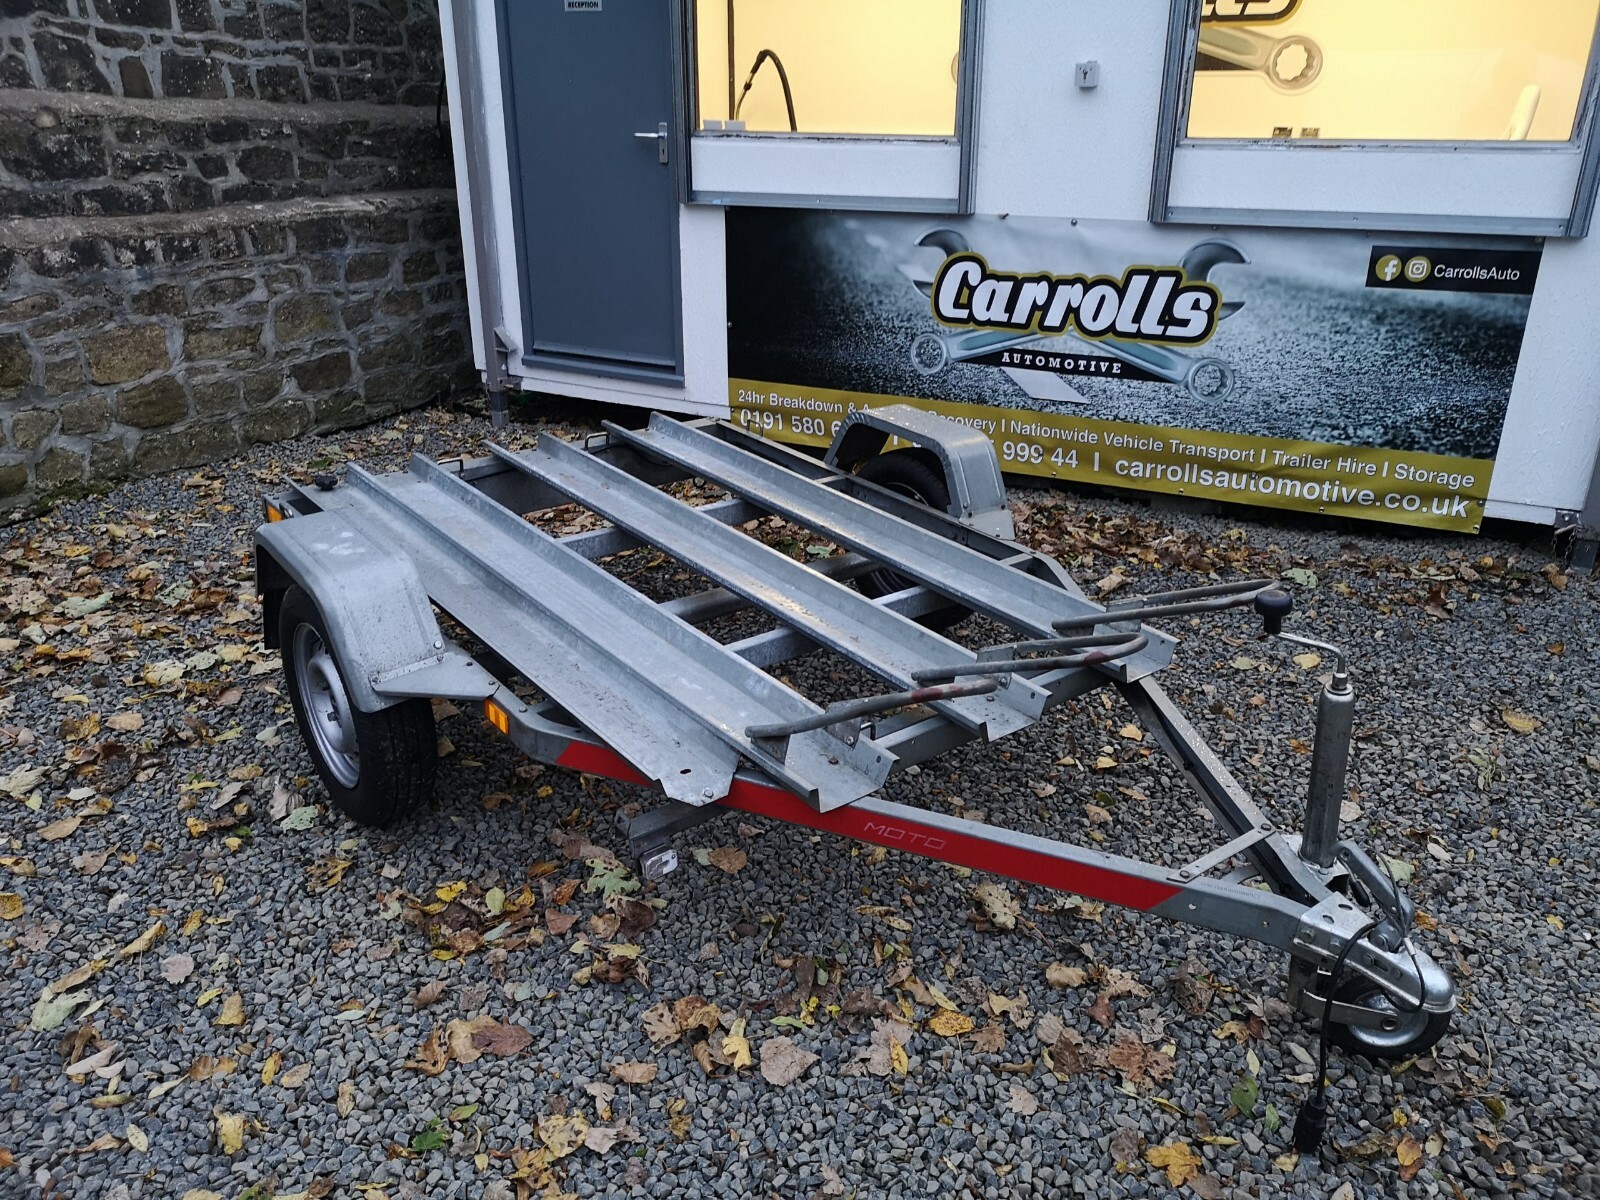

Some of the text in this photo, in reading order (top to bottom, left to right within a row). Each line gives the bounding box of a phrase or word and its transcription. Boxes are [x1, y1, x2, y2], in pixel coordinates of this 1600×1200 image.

[567, 0, 599, 9] RECEPTION
[1434, 264, 1520, 281] CarrollsAuto
[938, 260, 1212, 338] Carrolls
[1001, 352, 1122, 375] AUTOMOTIVE
[738, 389, 765, 404] 24hr
[769, 393, 843, 413] Breakdown
[848, 402, 857, 413] &
[928, 410, 996, 434] overy
[1010, 420, 1098, 444] Nationwide
[1103, 432, 1164, 452] Vehicle
[1169, 439, 1255, 462] Transport
[1272, 450, 1331, 470] Trailer
[1337, 457, 1377, 476] Hire
[1394, 463, 1475, 490] Storage
[740, 408, 783, 431] 0191
[791, 415, 825, 436] 580
[1002, 441, 1044, 464] 999
[1051, 447, 1078, 469] 44
[1115, 458, 1471, 518] carrollsautomotive.co.uk
[863, 822, 946, 850] MOTO
